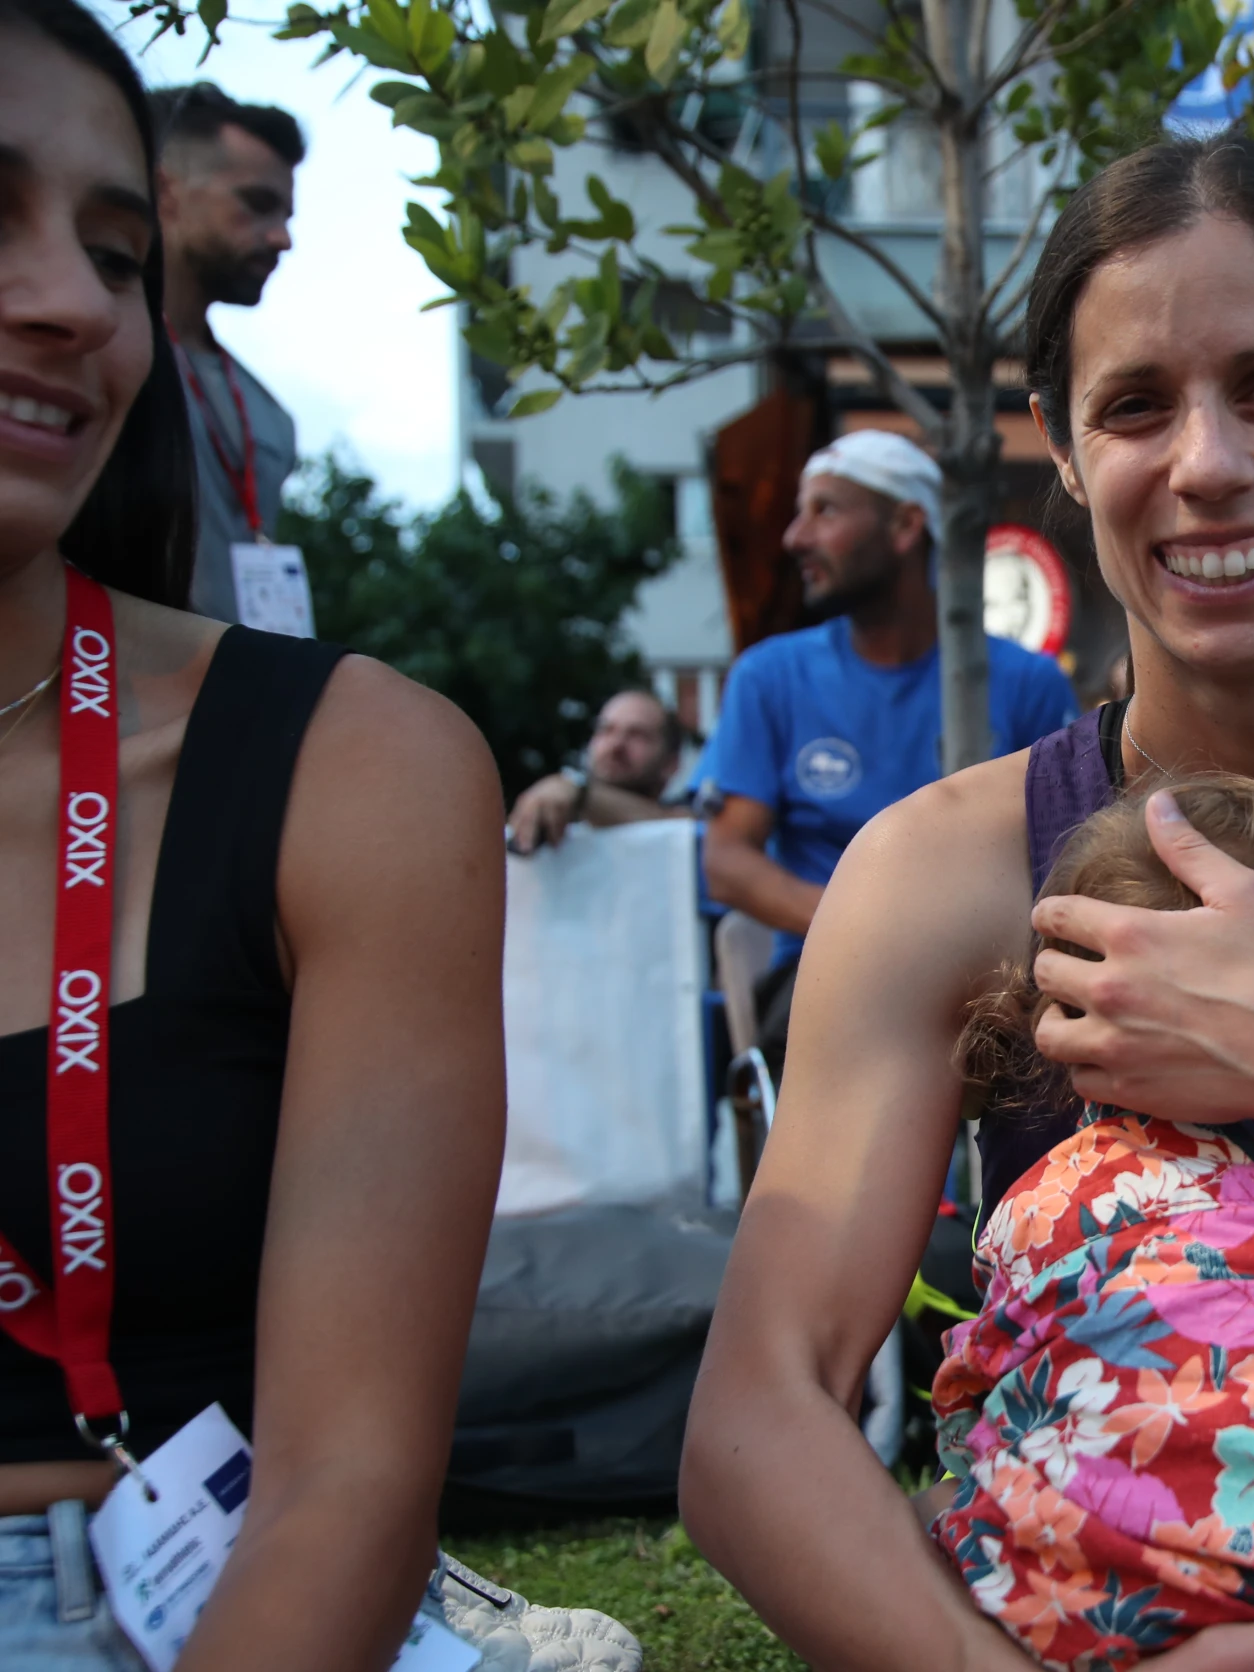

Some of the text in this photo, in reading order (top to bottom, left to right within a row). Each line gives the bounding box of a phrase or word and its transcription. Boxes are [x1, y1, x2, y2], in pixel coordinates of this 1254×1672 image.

[70, 627, 111, 718] XIXO
[65, 790, 109, 889] XIXO
[56, 969, 101, 1074] XIXO
[57, 1161, 107, 1275] XIXO
